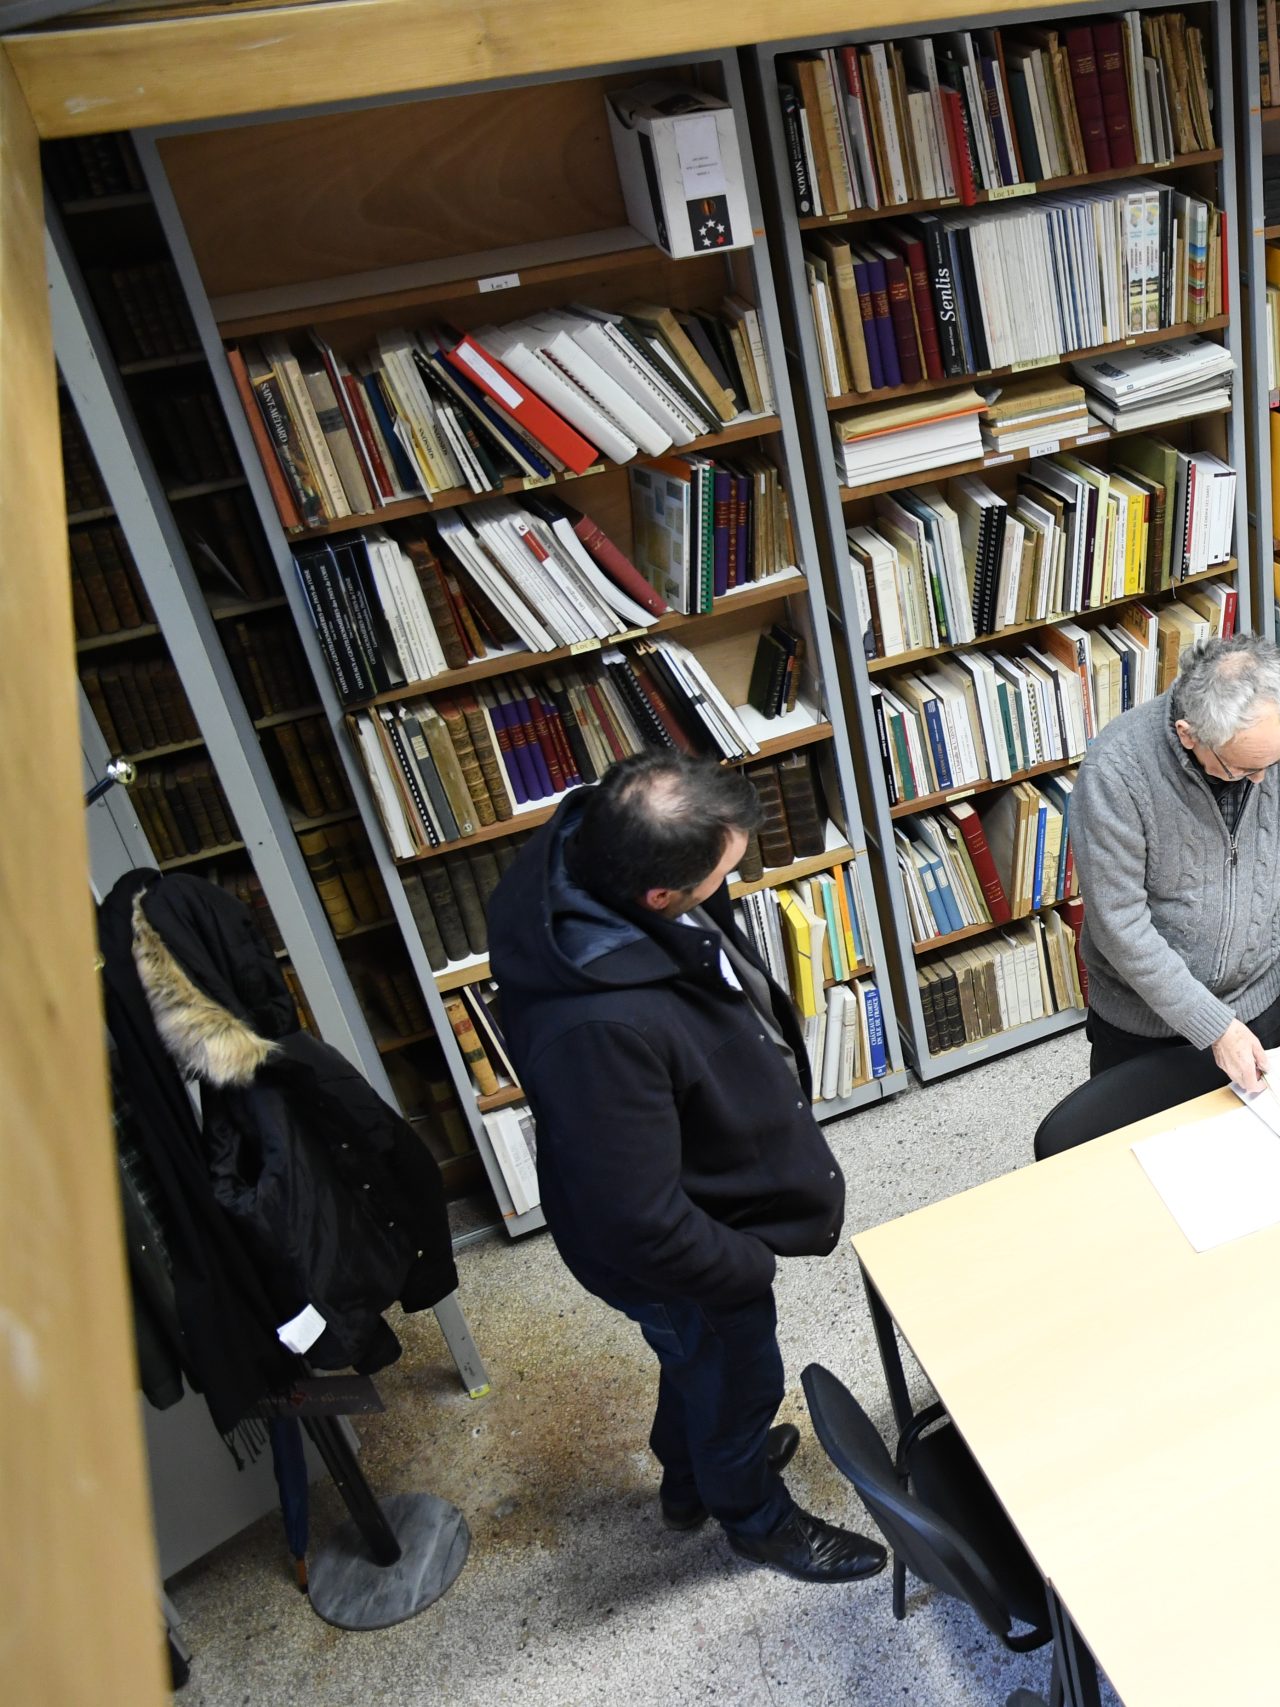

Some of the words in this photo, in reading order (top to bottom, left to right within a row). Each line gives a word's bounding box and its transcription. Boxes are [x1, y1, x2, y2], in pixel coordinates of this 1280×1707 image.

[794, 160, 806, 195] NOYON
[993, 190, 1004, 199] Loc
[933, 267, 956, 323] Senlis
[259, 382, 288, 442] SAINT-MÉDARD
[417, 427, 435, 459] SOISSONS
[431, 423, 448, 456] SOISSONS
[575, 642, 587, 650] Loc
[868, 1017, 877, 1045] CHÂTEAUX
[874, 1018, 880, 1026] DE
[877, 1036, 883, 1044] EN
